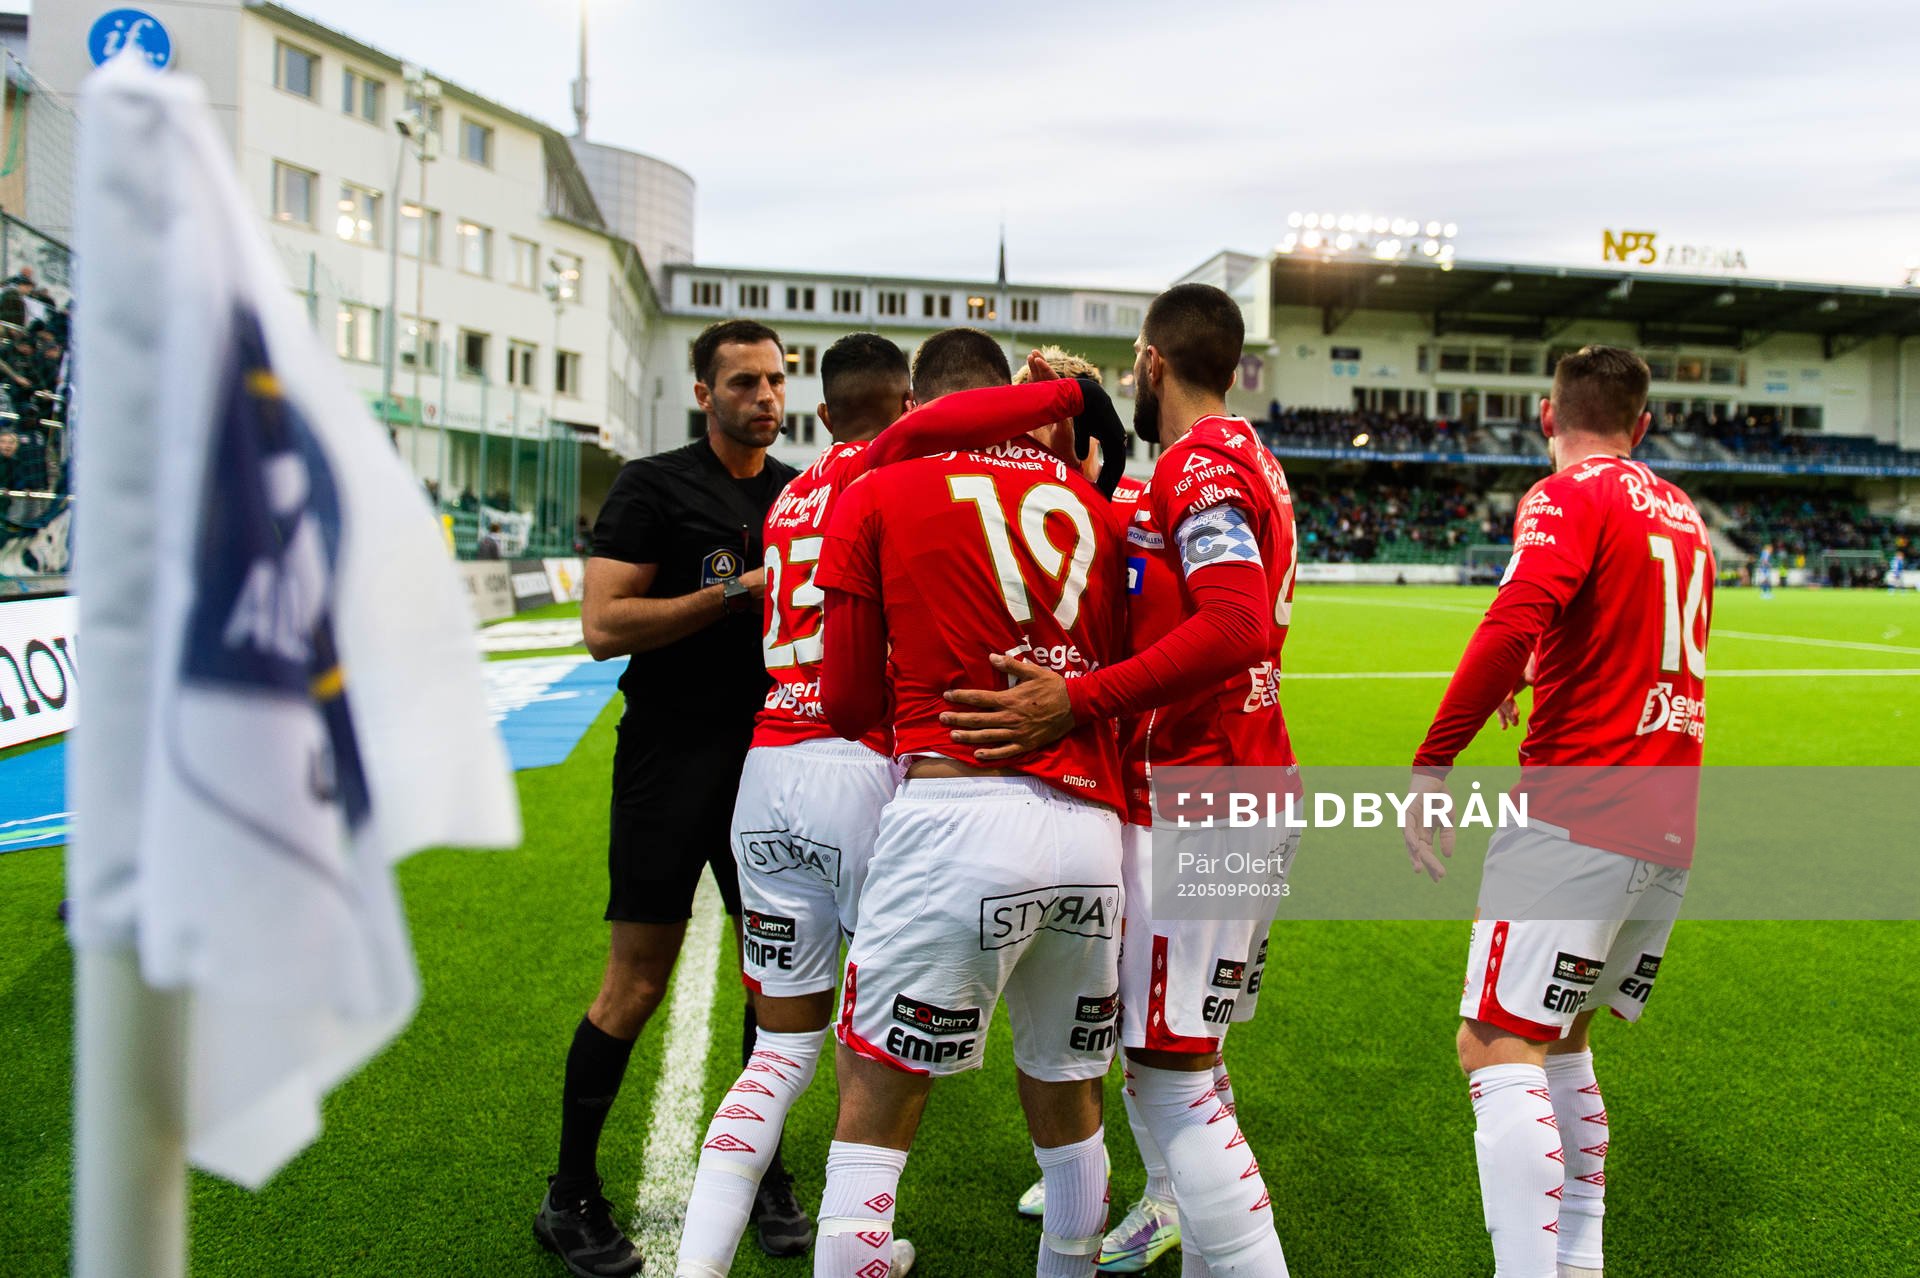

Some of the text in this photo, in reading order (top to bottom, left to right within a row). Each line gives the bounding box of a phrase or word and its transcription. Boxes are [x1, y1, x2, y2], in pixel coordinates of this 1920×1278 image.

[1603, 230, 1657, 264] NP3
[968, 454, 1044, 471] IT-PARTNER
[1174, 476, 1194, 497] JGF
[1195, 464, 1236, 483] INFRA
[1189, 487, 1242, 515] AURORA
[1528, 505, 1563, 517] INFRA
[946, 474, 1098, 631] 19
[1186, 525, 1229, 564] C
[763, 535, 825, 668] 23
[1648, 534, 1708, 680] 16
[1063, 774, 1097, 788] umbro
[897, 1004, 975, 1028] SEQURITY
[886, 1026, 976, 1063] EMPE
